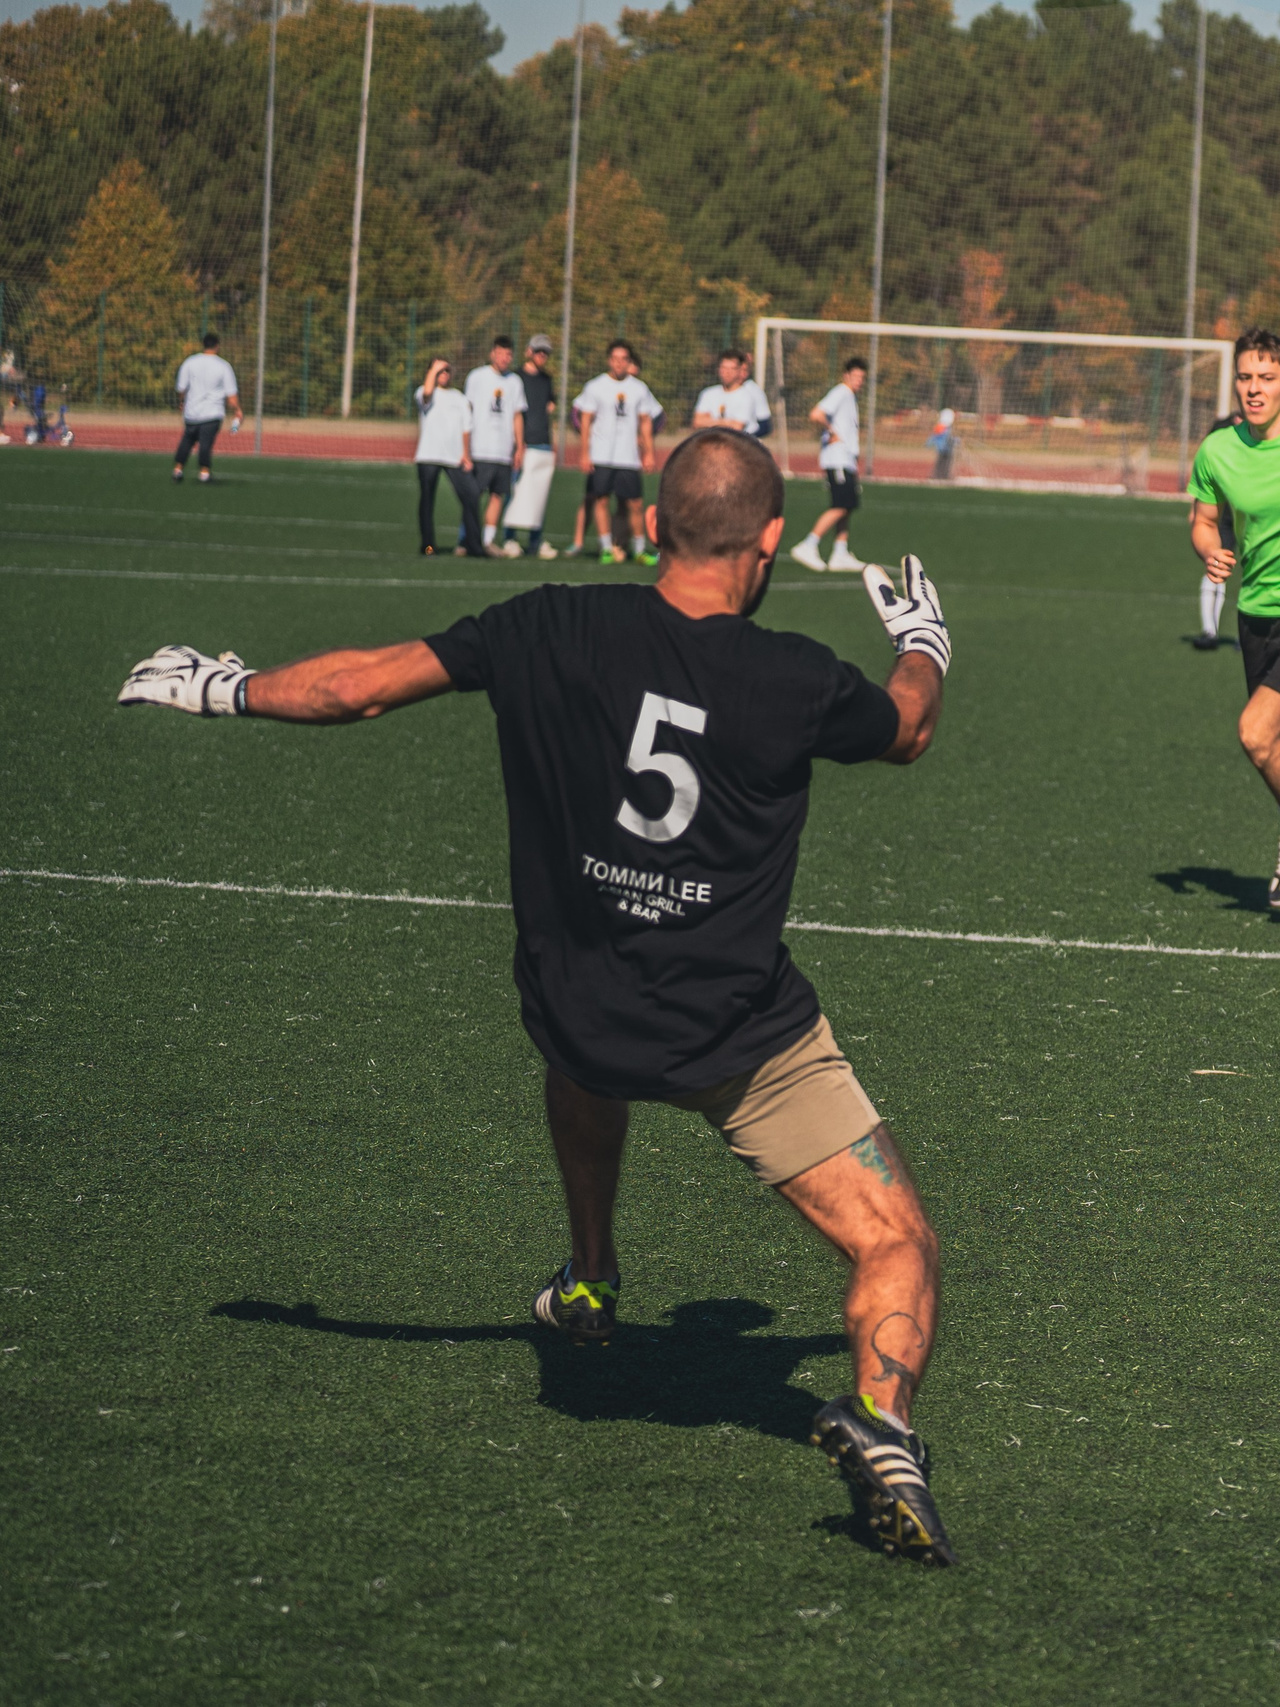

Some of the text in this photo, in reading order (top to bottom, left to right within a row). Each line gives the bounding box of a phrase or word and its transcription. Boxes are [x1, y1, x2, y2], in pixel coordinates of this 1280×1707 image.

[615, 691, 708, 842] 5
[668, 877, 712, 903] LEE
[617, 900, 661, 924] & BAR
[645, 894, 685, 916] GRILL
